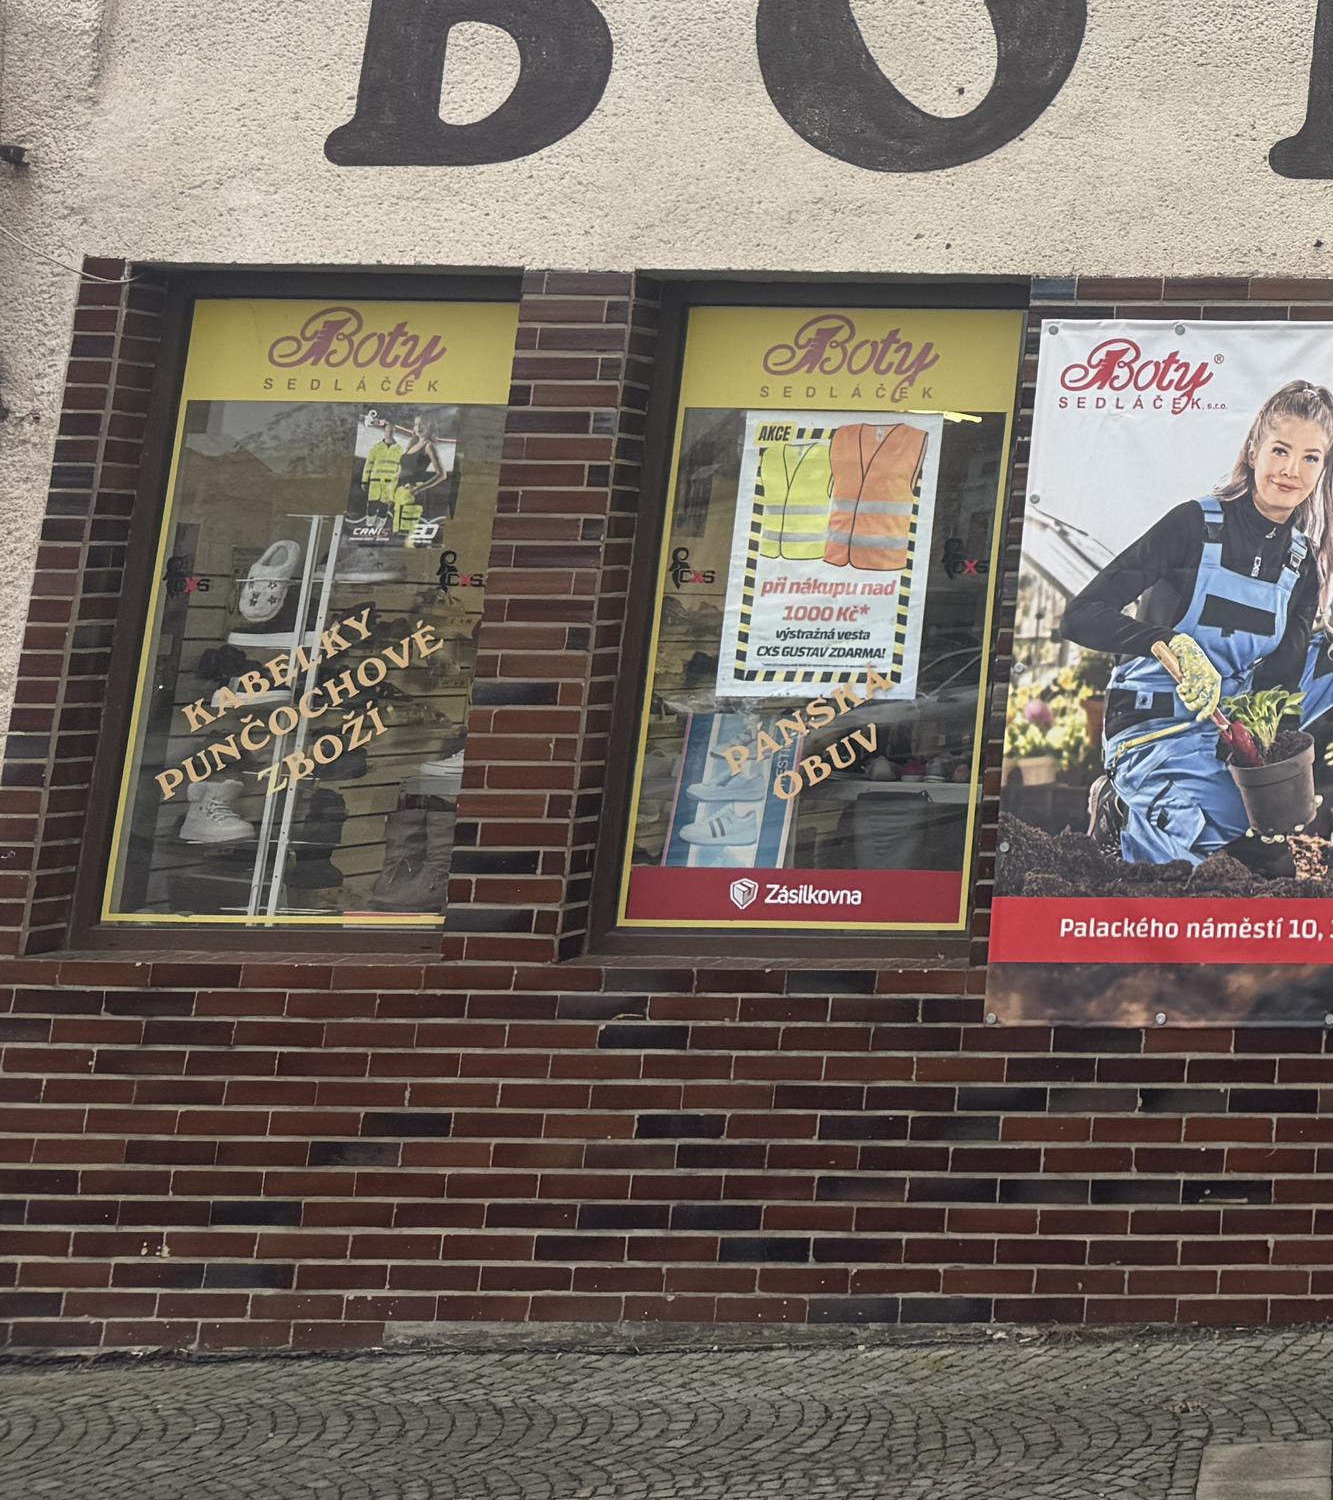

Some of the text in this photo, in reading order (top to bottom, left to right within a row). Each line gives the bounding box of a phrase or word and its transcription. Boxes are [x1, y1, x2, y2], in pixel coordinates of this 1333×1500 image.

[267, 306, 447, 396] Boty
[763, 314, 940, 403] Boty
[263, 376, 439, 392] SEDLÁČEK
[1060, 338, 1213, 415] Boty
[760, 383, 933, 399] SEDLÁČEK
[758, 426, 791, 441] AKCE
[679, 570, 715, 583] CXS
[761, 576, 897, 598] při nákupu nad
[782, 605, 833, 622] 1000
[776, 627, 871, 642] výstražná vesta
[756, 646, 886, 659] CXS GUSTAV ZDARMA!
[181, 607, 373, 732] KABELKY
[154, 620, 445, 800] PUNČOCHOVÉ
[723, 661, 893, 776] PÁNSKÁ
[257, 701, 389, 797] ZBOŽÍ
[773, 723, 879, 801] OBUV
[764, 884, 862, 906] Zásilkovna
[1059, 917, 1179, 939] Palackého
[1186, 917, 1284, 939] náměstí
[1288, 918, 1323, 942] 10,
